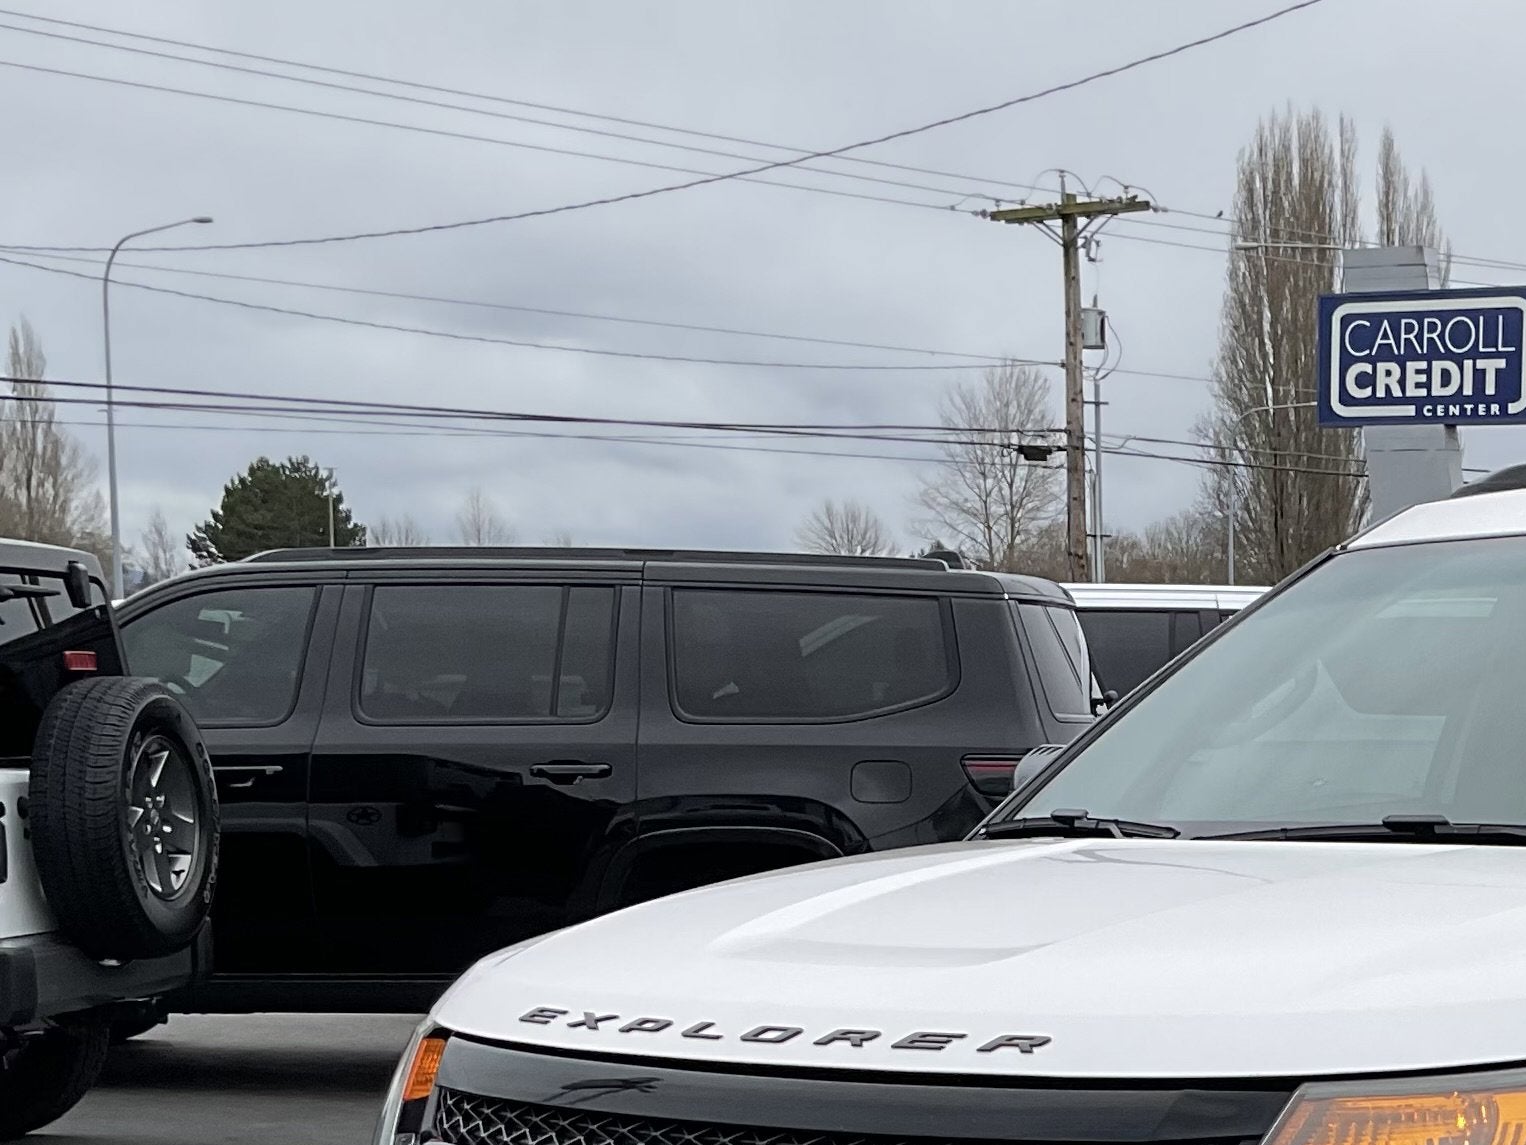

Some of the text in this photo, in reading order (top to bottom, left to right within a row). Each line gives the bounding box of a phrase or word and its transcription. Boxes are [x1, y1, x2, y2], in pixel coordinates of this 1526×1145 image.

[1344, 315, 1516, 357] CARROLL
[1345, 358, 1507, 399] CREDIT
[1422, 403, 1501, 417] CENTER
[518, 1005, 1053, 1055] EXPLORER
